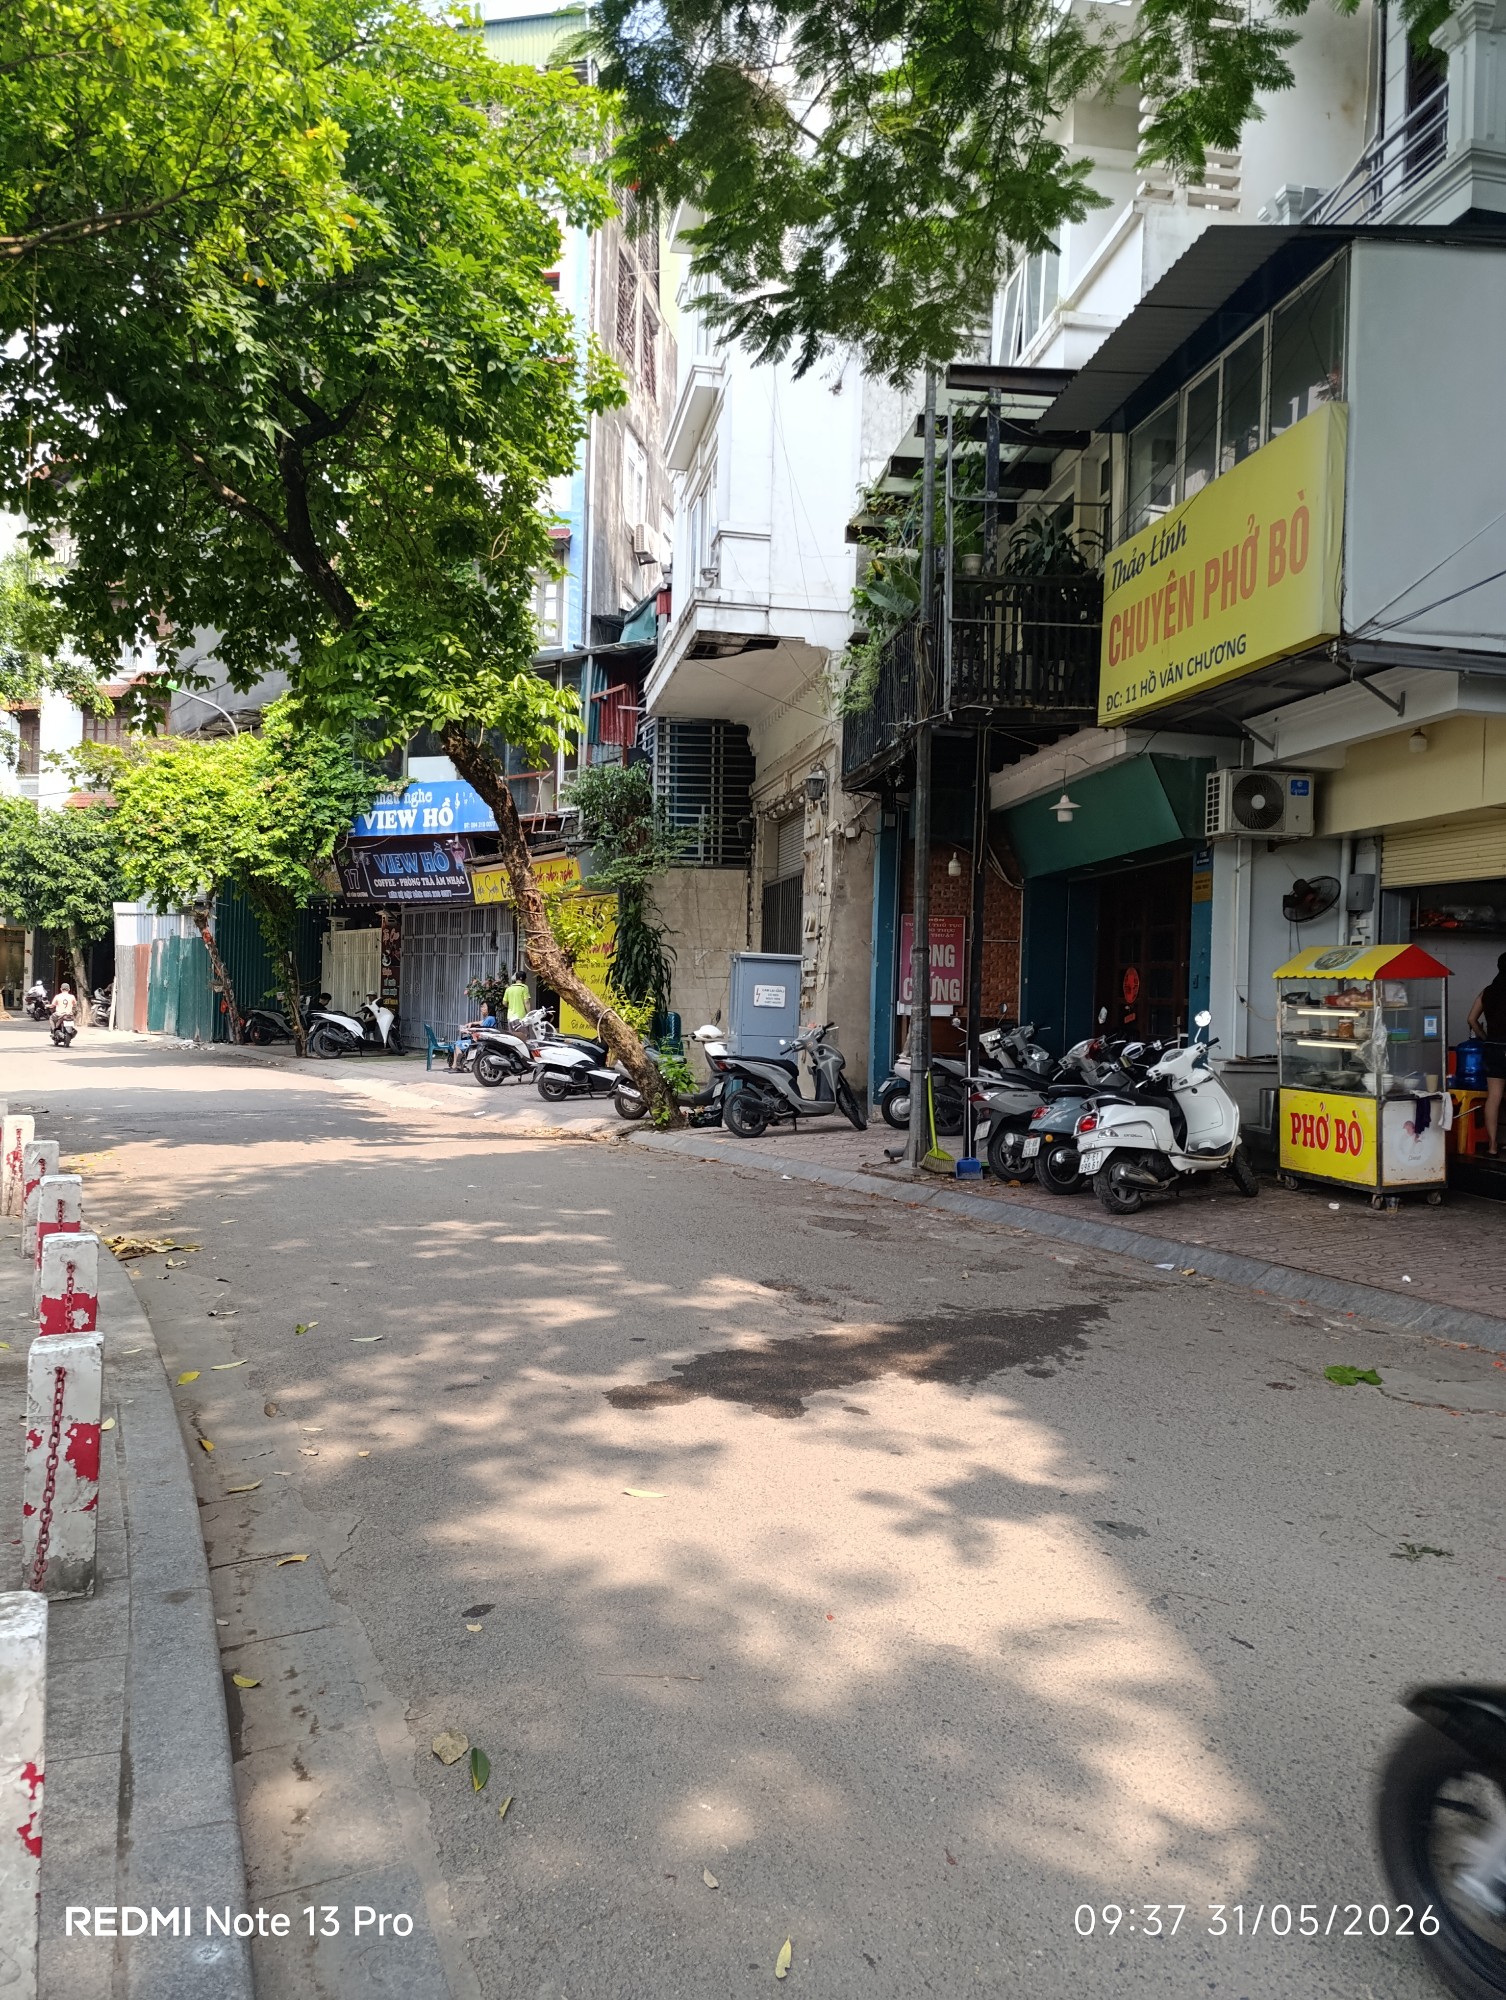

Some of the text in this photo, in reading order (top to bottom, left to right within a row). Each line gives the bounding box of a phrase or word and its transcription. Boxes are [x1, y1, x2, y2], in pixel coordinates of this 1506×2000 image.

[1108, 489, 1310, 668] CHUYÊN PHỞ BÒ
[1111, 547, 1144, 591] Thảo
[1106, 633, 1247, 713] ĐC: 11 HỒ VĂN CHƯƠNG
[362, 797, 454, 830] VIEW HỒ
[373, 842, 450, 875] VIEW HỒ
[343, 868, 360, 890] 17
[373, 879, 396, 888] COFFEE
[399, 875, 421, 887] PHÒNG
[421, 874, 435, 886] TRÀ
[447, 875, 466, 888] NHẠC
[903, 971, 960, 1002] CỨNG
[62, 998, 69, 1009] 9
[1290, 1102, 1364, 1157] PHỞ BÒ
